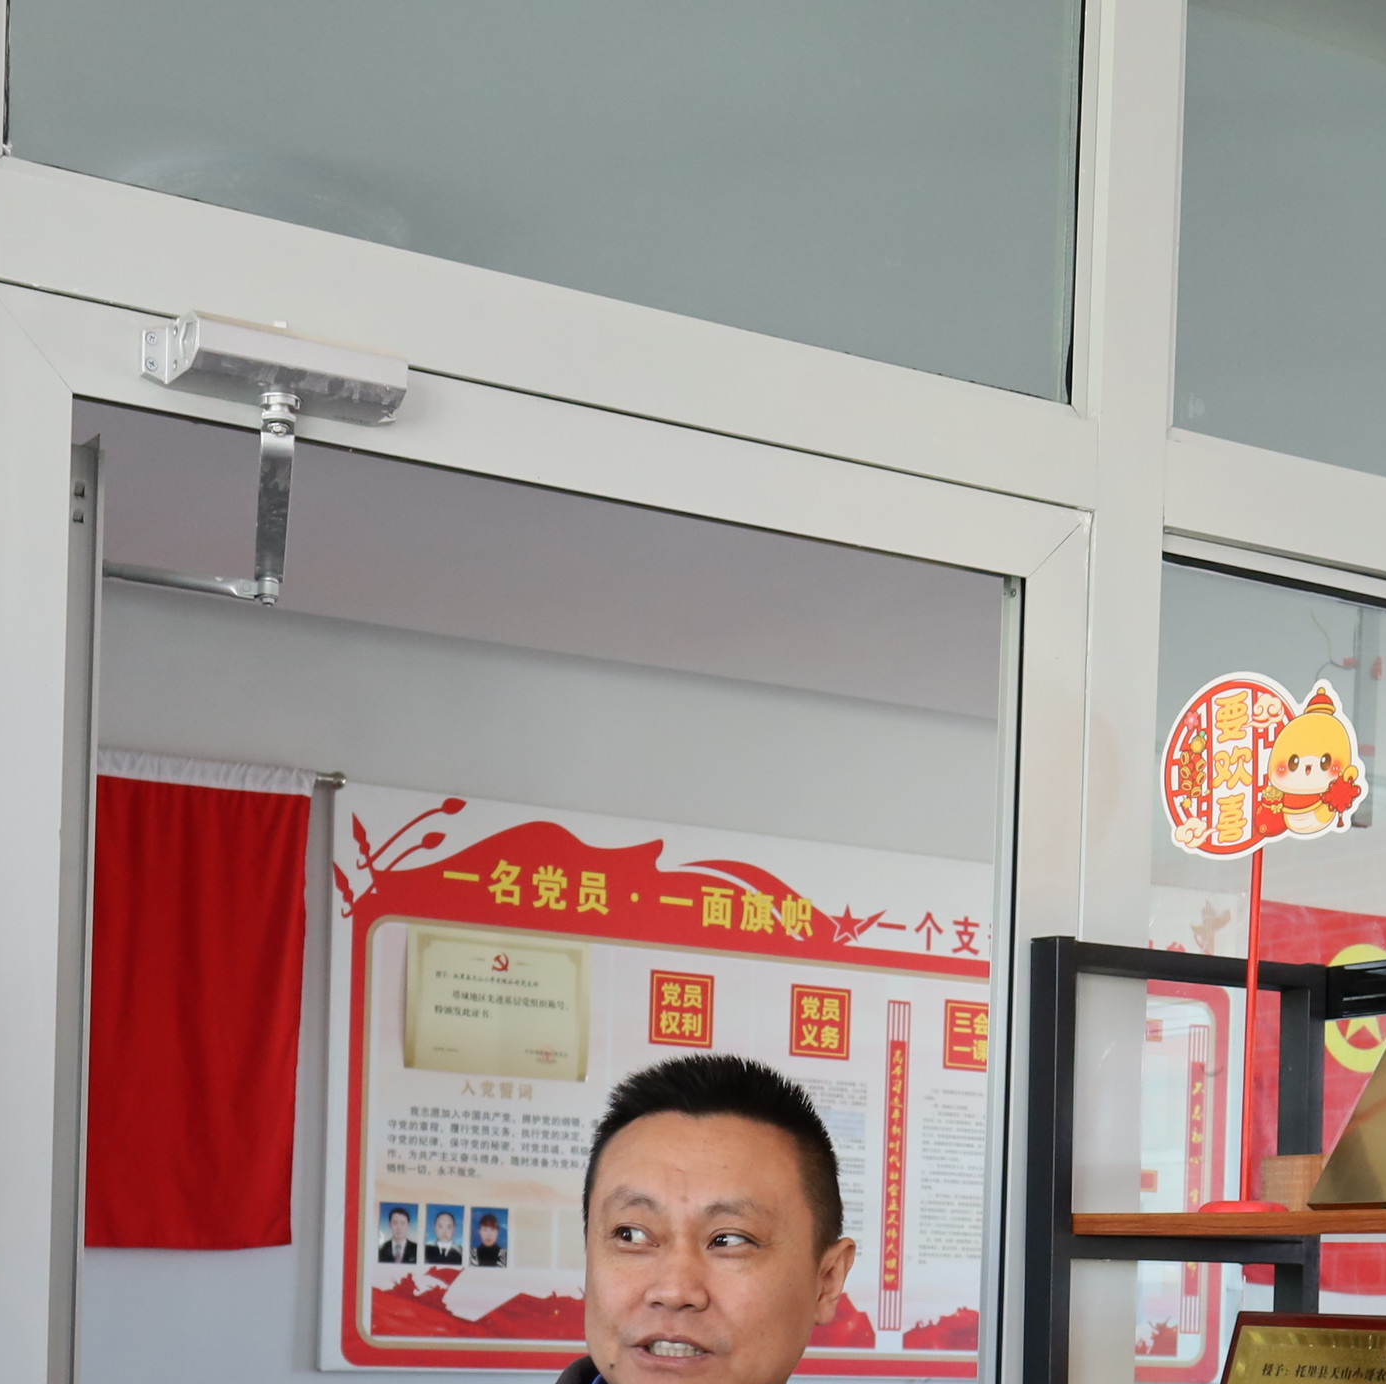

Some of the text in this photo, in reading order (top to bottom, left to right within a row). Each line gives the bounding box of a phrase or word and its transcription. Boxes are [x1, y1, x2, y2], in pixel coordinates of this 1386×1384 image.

[1213, 690, 1253, 844] 要欢喜
[876, 910, 991, 956] 一个支
[661, 982, 703, 1009] 党员
[800, 996, 840, 1022] 党员
[659, 1010, 703, 1037] 权利
[799, 1024, 840, 1049] 义务
